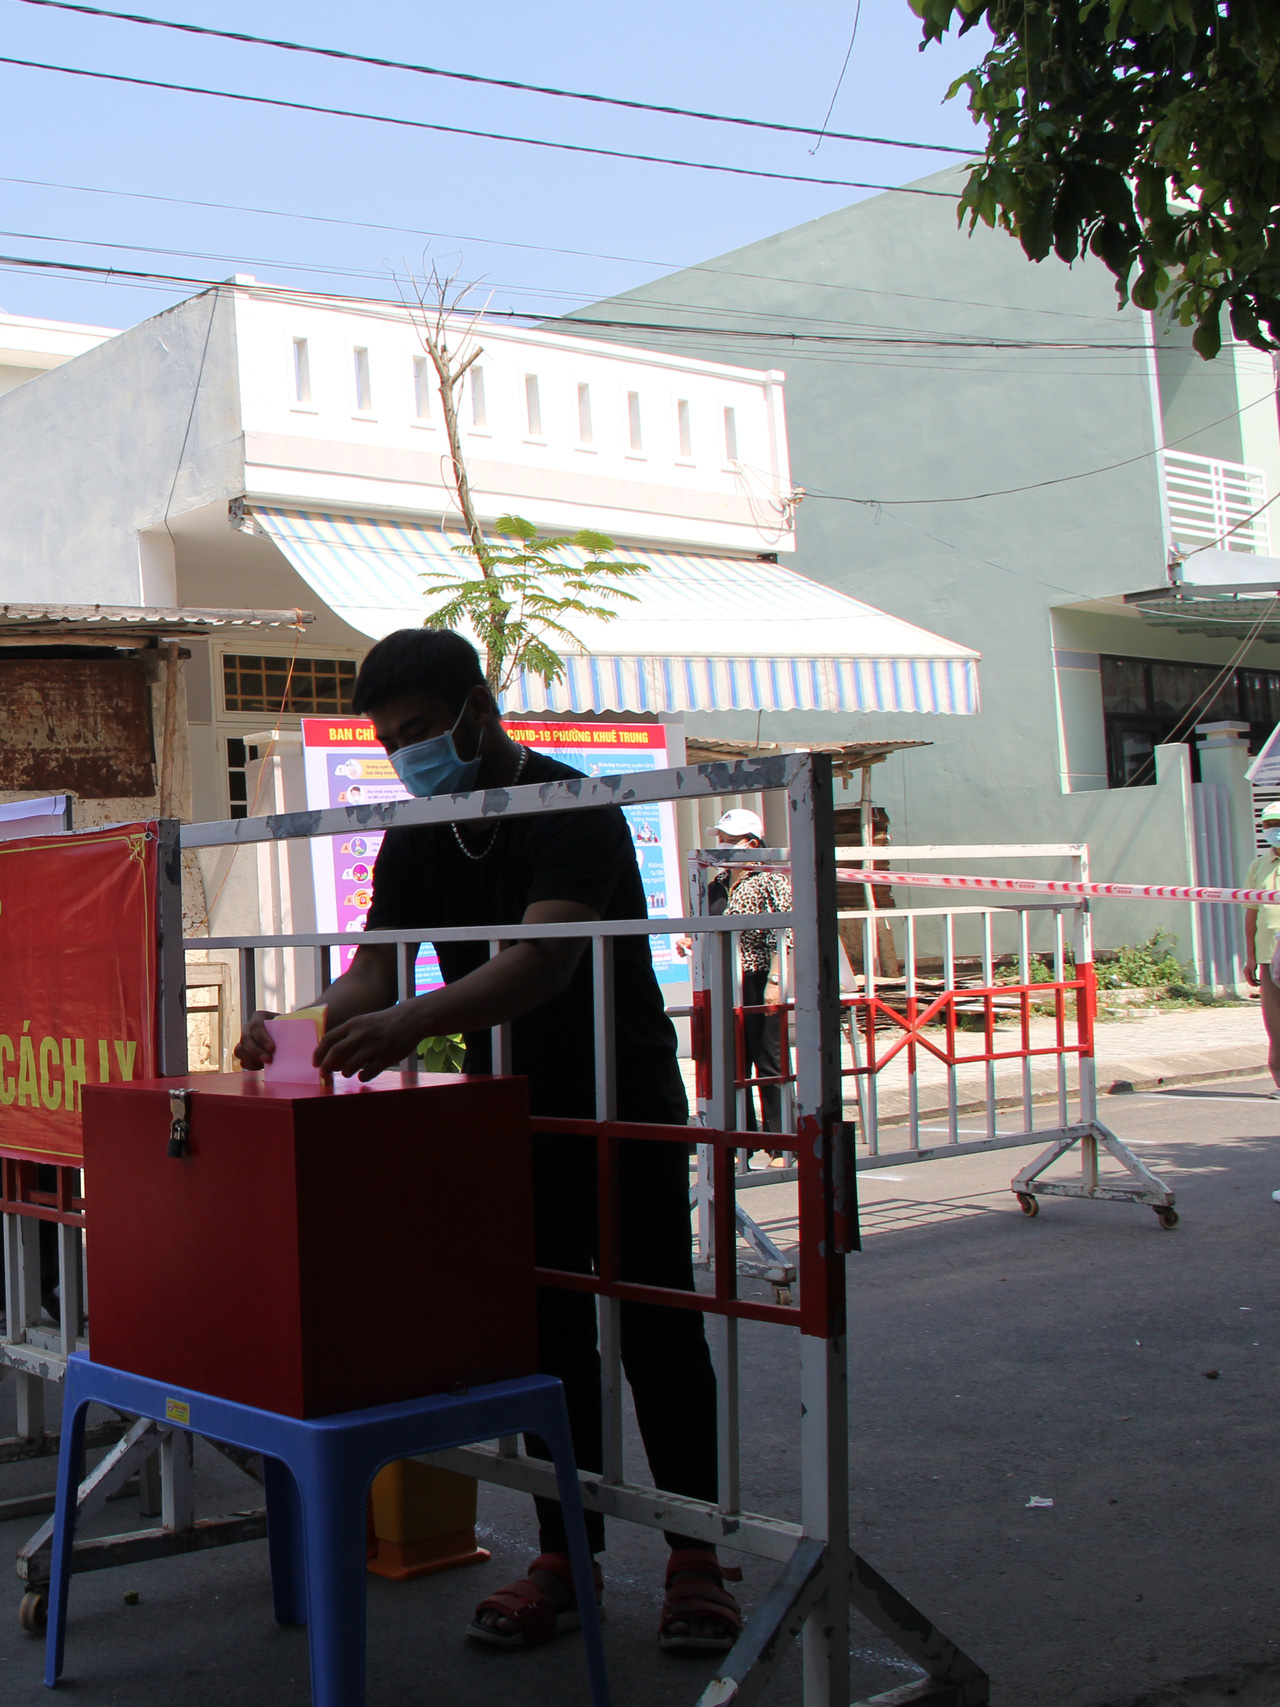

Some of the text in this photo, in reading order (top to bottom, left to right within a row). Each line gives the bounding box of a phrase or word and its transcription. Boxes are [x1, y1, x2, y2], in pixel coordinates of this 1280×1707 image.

[328, 724, 375, 741] BAN CHỈ
[506, 727, 649, 744] COVID-19 PHƯỜNG KHUÊ TRUNG
